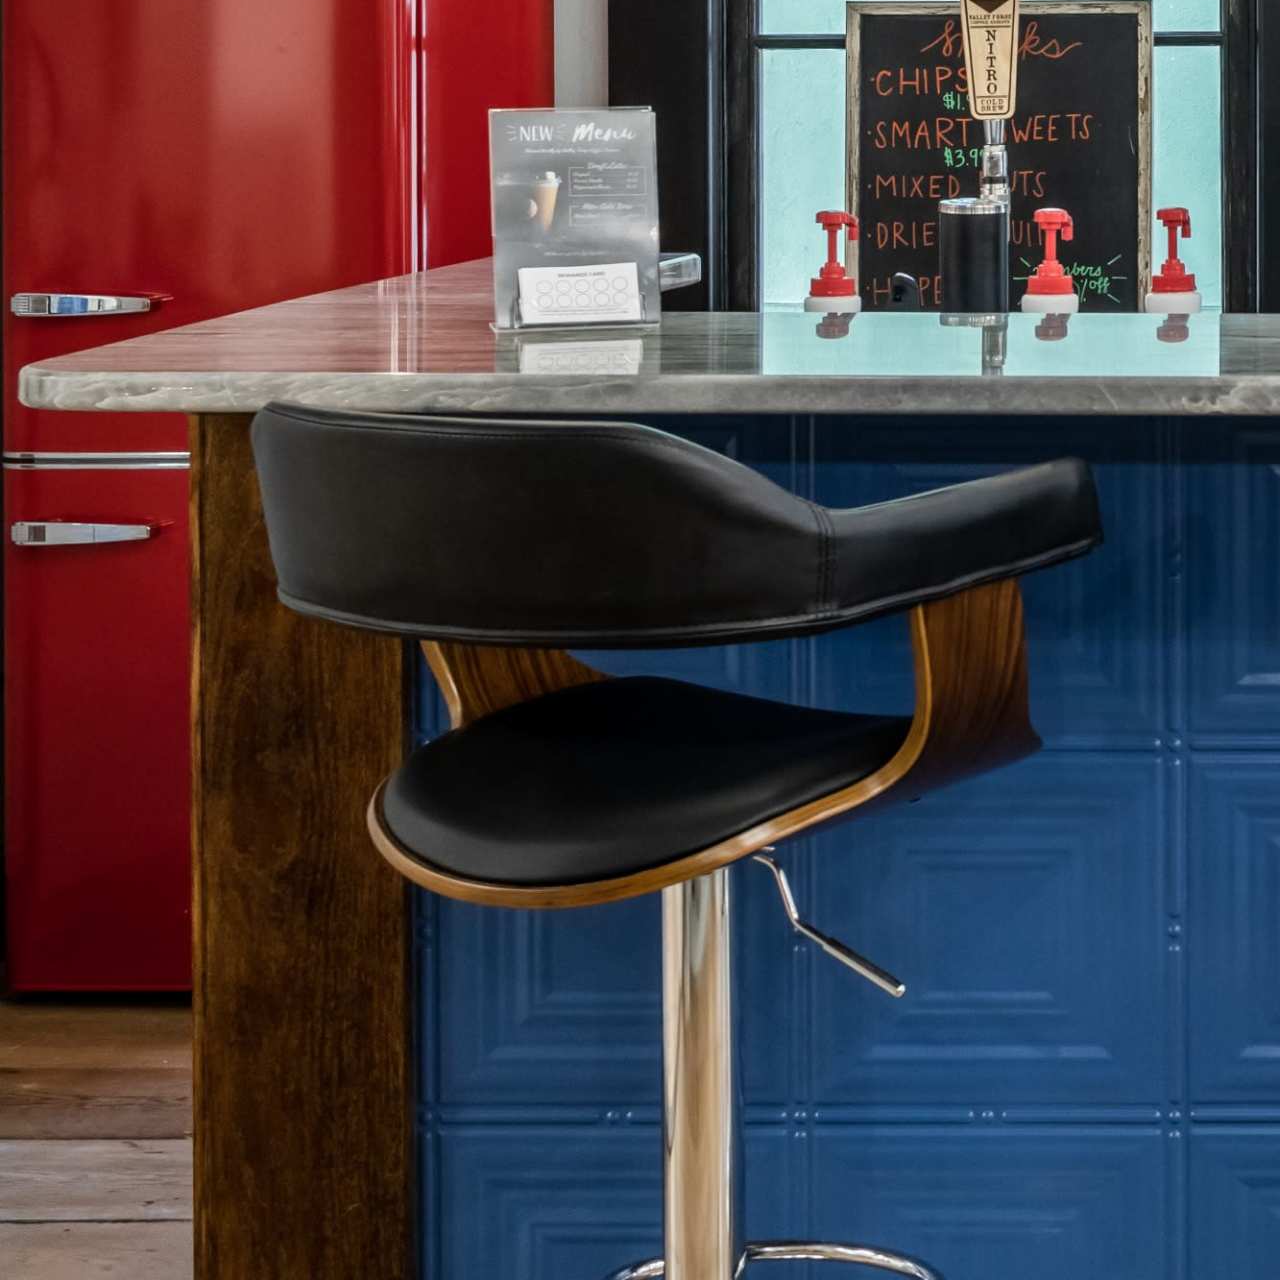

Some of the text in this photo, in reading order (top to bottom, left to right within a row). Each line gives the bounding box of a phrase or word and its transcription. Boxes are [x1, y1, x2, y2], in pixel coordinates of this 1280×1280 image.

[985, 30, 998, 94] NITRO
[519, 122, 637, 143] NEW Menu
[875, 113, 1094, 150] SMART WEETS
[875, 175, 961, 199] MIXED
[877, 221, 937, 249] DRIE
